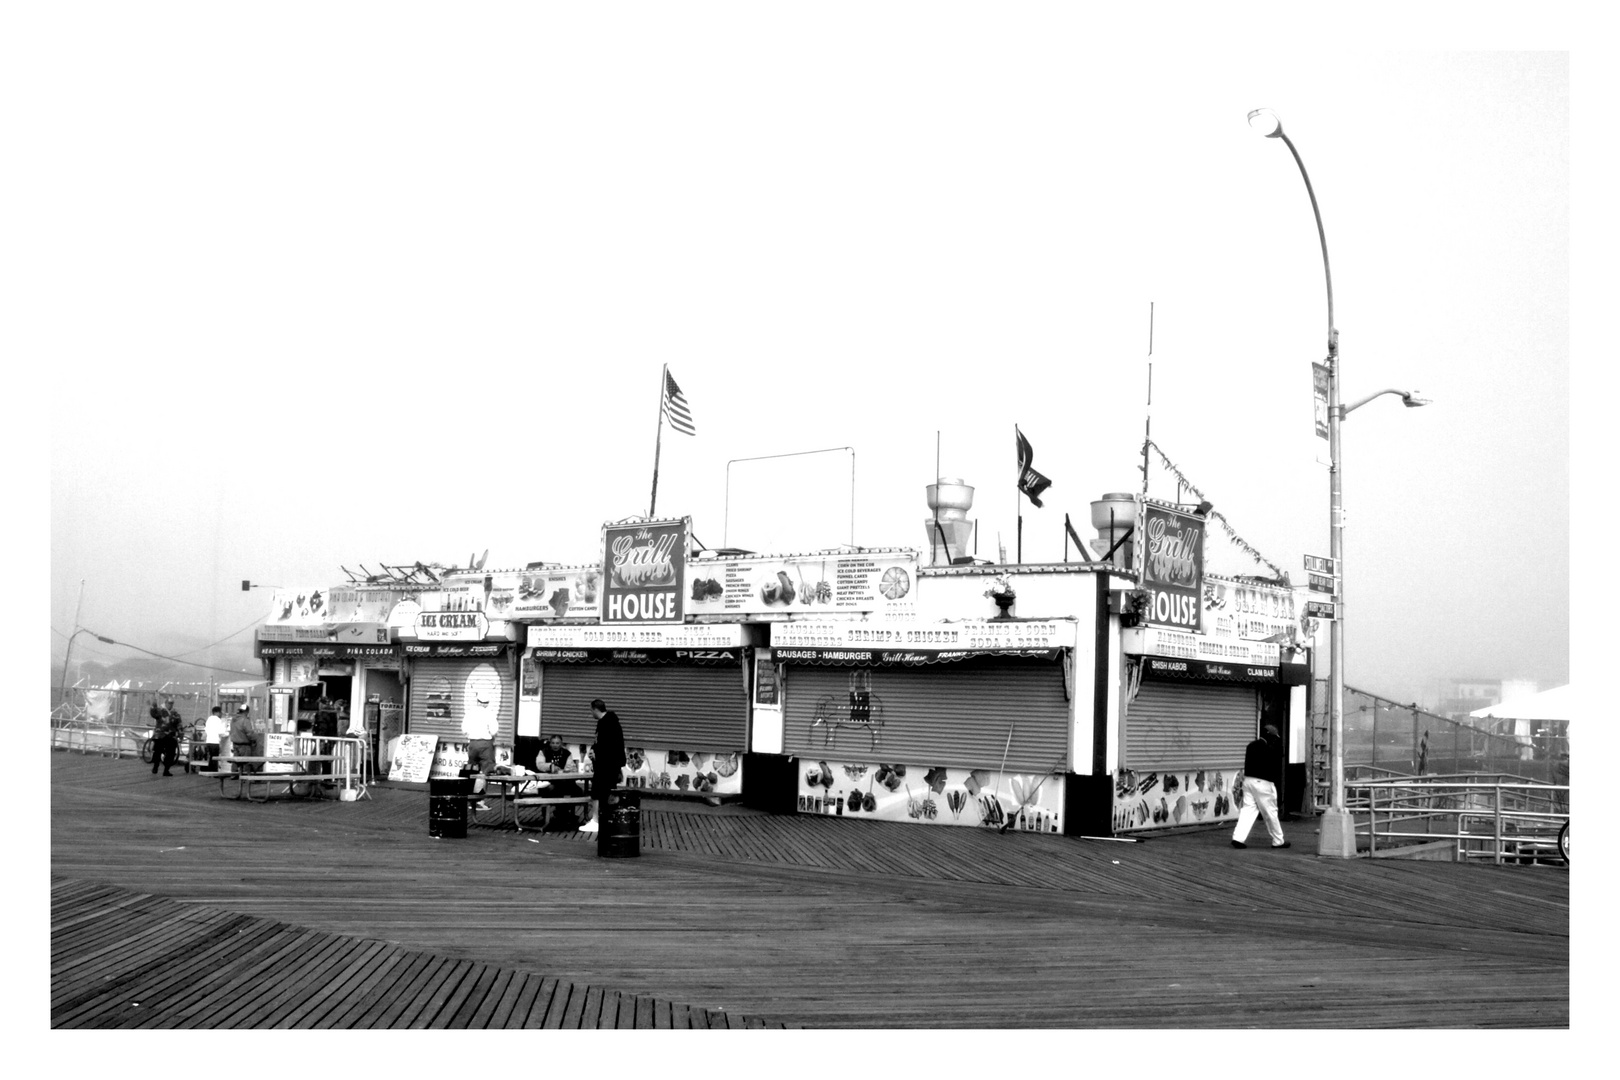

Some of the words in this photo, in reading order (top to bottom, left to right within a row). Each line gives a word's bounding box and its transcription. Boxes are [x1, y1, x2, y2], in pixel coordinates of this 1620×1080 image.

[1167, 513, 1181, 529] The
[635, 528, 653, 541] The
[1147, 517, 1199, 562] Grill
[611, 534, 678, 567] Grill
[608, 592, 676, 620] HOUSE
[1144, 589, 1197, 626] HOUSE
[420, 614, 436, 627] ICE
[439, 614, 477, 628] CREAM
[684, 626, 712, 636] PIZZA
[783, 625, 834, 634] SAUSAGES
[964, 625, 1010, 635] FRANKS
[1015, 625, 1022, 635] &
[1026, 625, 1056, 635] CORN
[584, 632, 604, 642] COLD
[606, 632, 628, 642] SODA
[631, 632, 636, 642] &
[640, 632, 662, 642] BEER
[774, 636, 842, 646] HAMBURGERS
[848, 630, 892, 642] SHRIMP
[895, 631, 902, 642] &
[907, 631, 958, 642] CHICKEN
[666, 637, 687, 646] FRIES
[690, 638, 695, 646] &
[698, 637, 731, 646] KNISHES
[970, 638, 1000, 648] SODA
[1006, 638, 1013, 648] &
[1018, 638, 1049, 648] BEER
[562, 650, 588, 658] CHICKEN
[675, 651, 734, 659] PIZZA
[777, 650, 817, 658] SAUSAGES
[822, 652, 872, 660] HAMBURGER
[882, 652, 903, 662] Grill
[902, 652, 928, 661] House
[1152, 660, 1167, 670] SHISH
[1168, 662, 1187, 671] KABOB
[1247, 668, 1263, 676] CLAM
[448, 759, 452, 767] &
